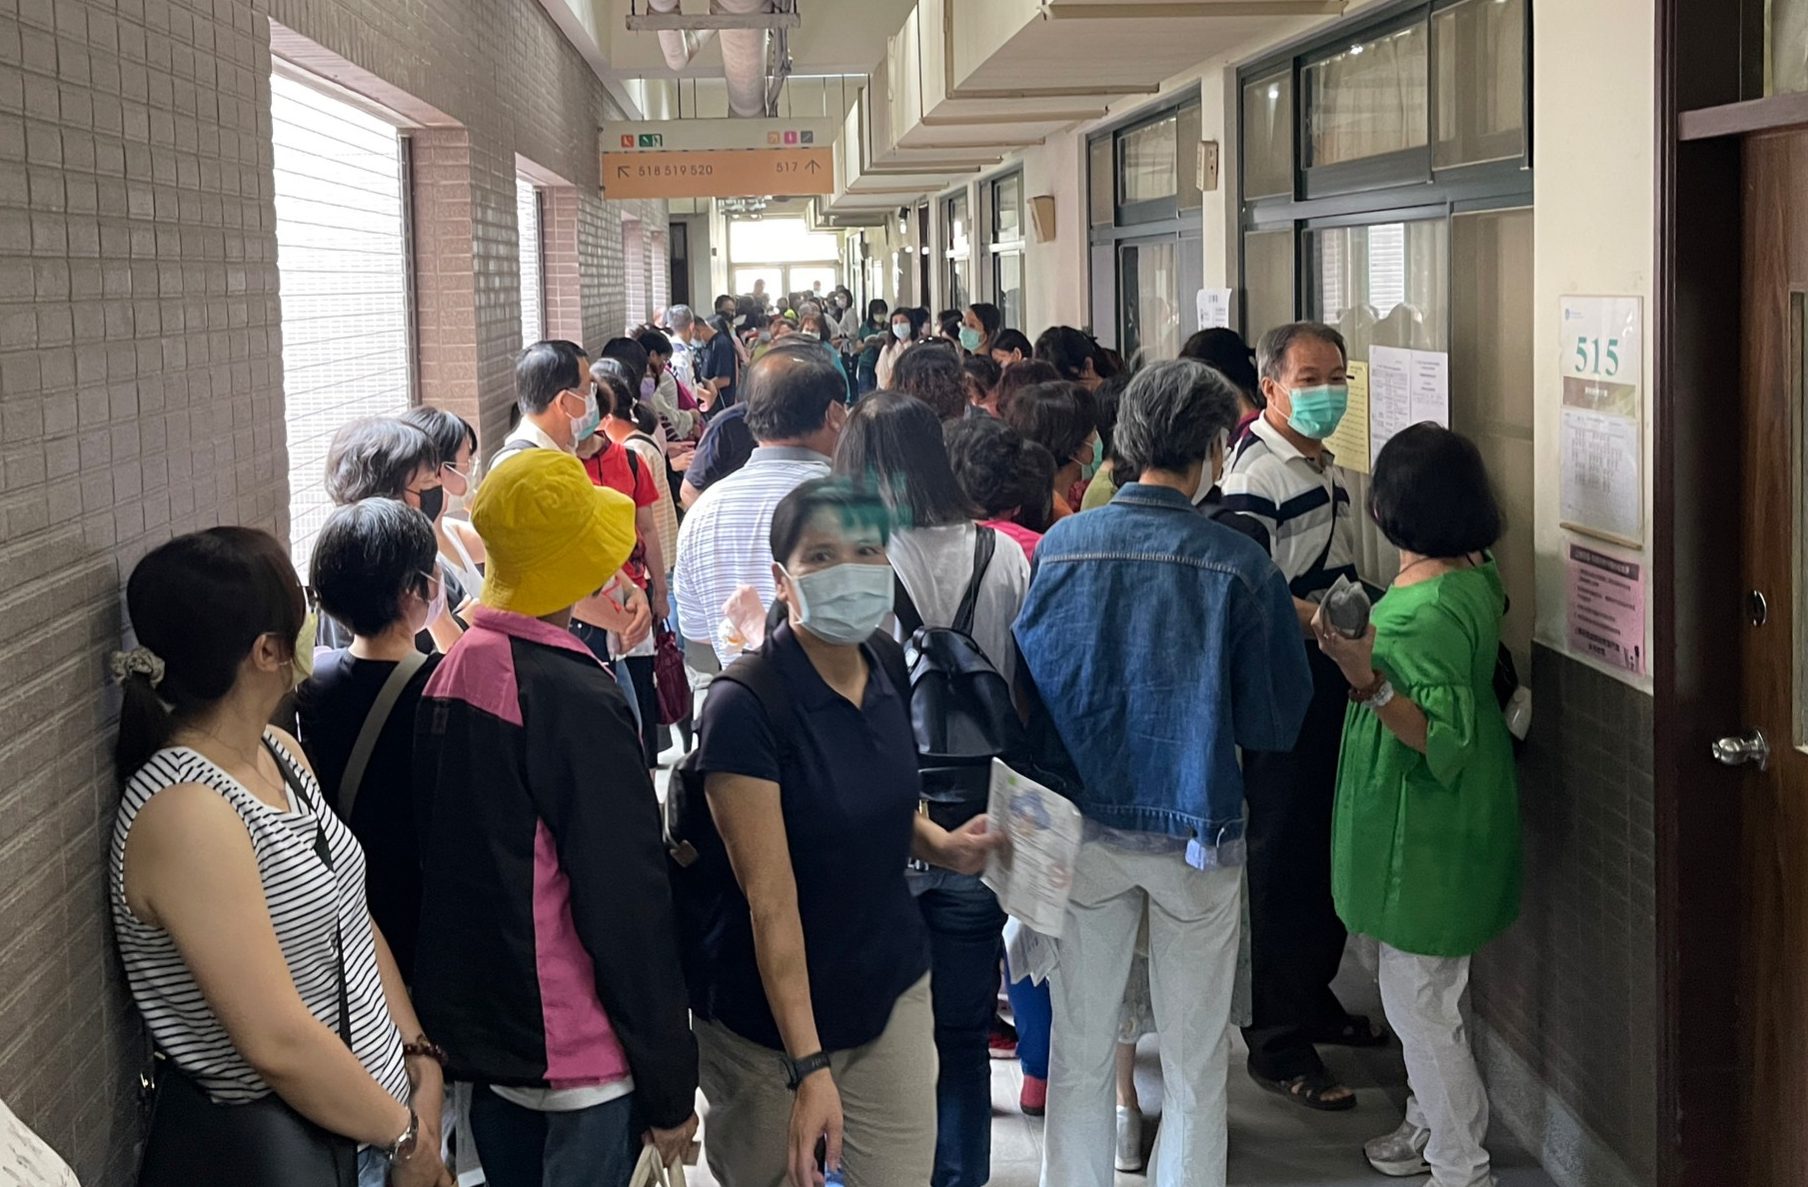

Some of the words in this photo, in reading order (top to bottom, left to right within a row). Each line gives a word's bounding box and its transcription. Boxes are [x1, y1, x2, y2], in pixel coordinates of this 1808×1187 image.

[638, 165, 660, 177] 518
[664, 165, 687, 176] 519
[690, 164, 713, 176] 520
[776, 161, 798, 173] 517
[1575, 336, 1619, 376] 515
